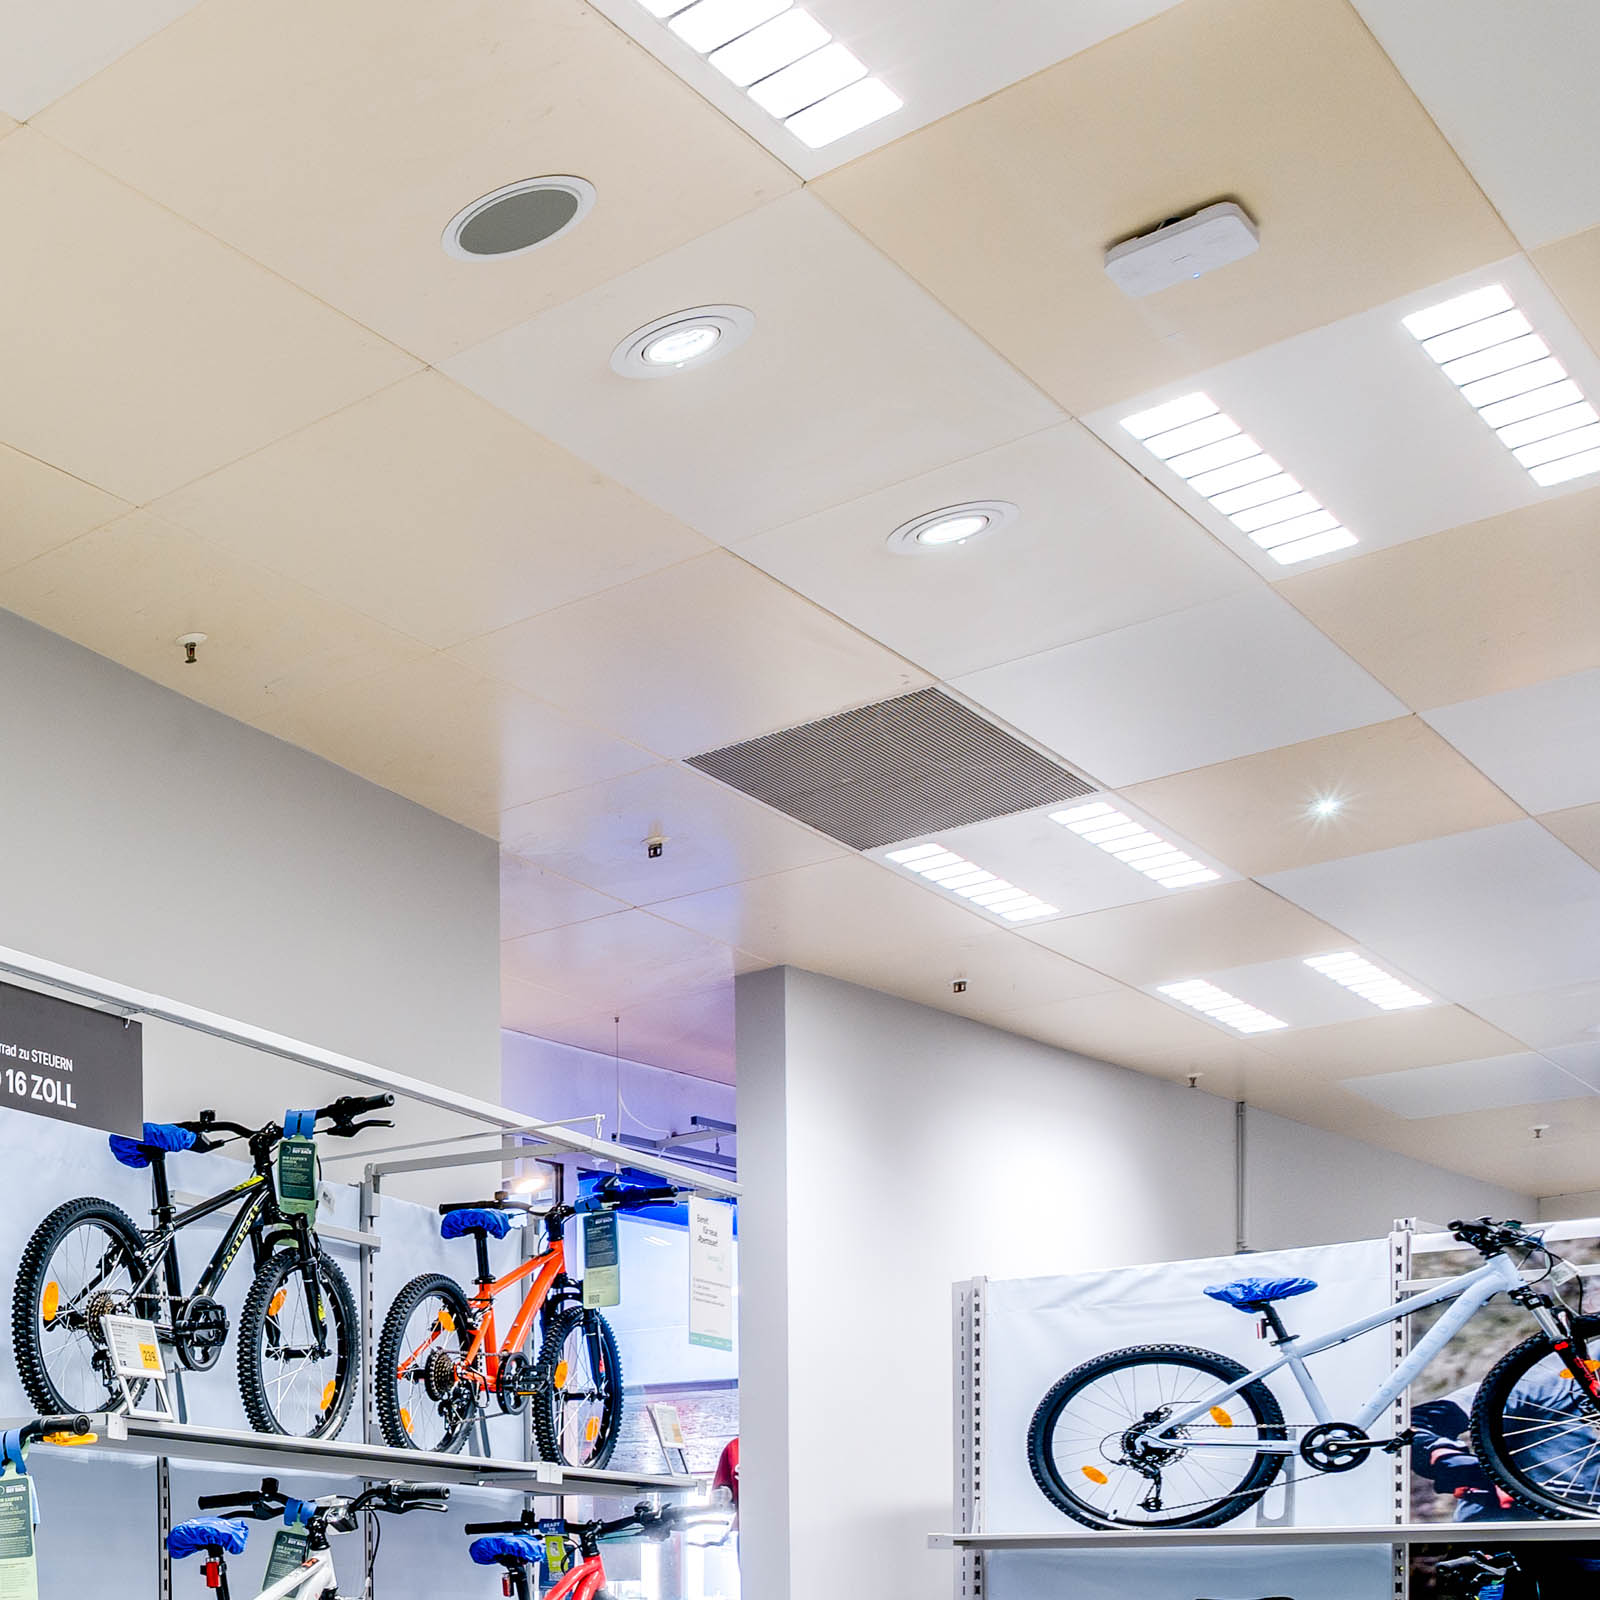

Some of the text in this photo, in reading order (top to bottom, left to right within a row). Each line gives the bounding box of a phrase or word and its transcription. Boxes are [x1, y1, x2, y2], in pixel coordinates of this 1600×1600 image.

[18, 1048, 30, 1060] zu
[31, 1049, 73, 1072] STEUERN
[6, 1068, 27, 1096] 16
[31, 1074, 77, 1109] ZOLL
